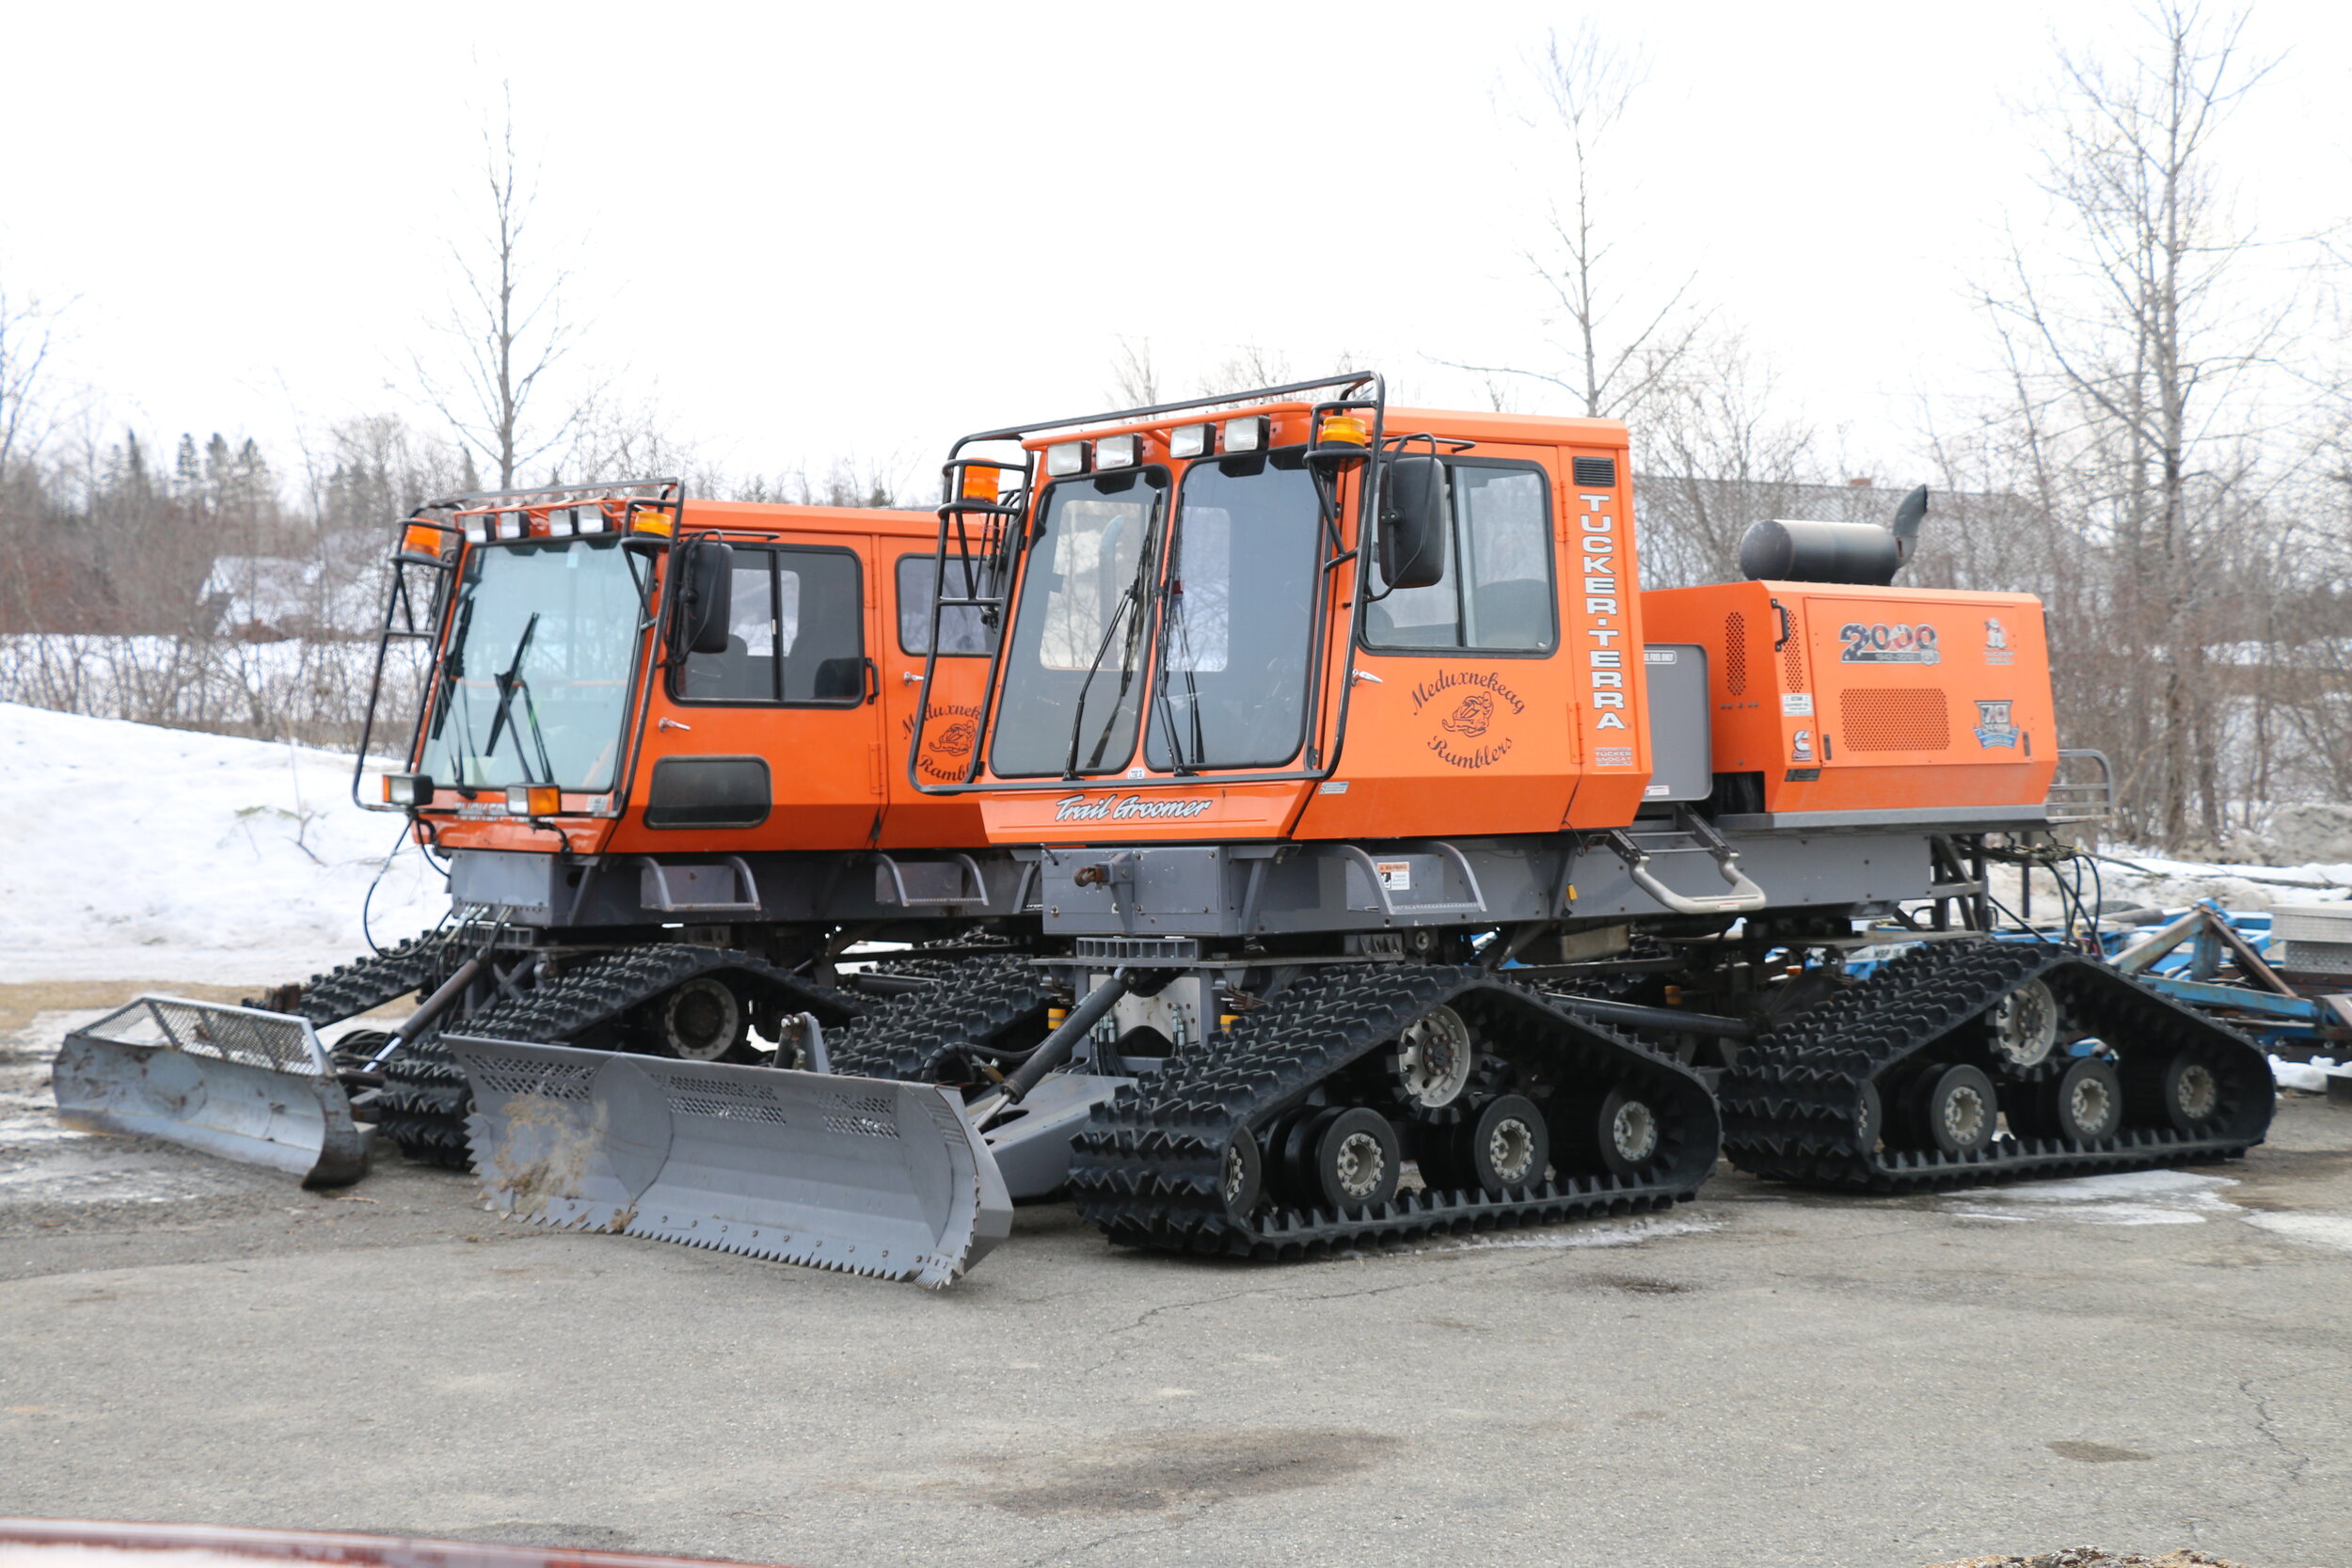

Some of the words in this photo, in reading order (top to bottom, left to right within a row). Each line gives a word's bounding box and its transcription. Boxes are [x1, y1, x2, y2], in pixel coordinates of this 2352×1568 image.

[1839, 623, 1938, 662] 2000
[1412, 670, 1525, 716] Meduxnekeag
[1055, 794, 1118, 821] Trail
[1112, 795, 1213, 819] Groomer
